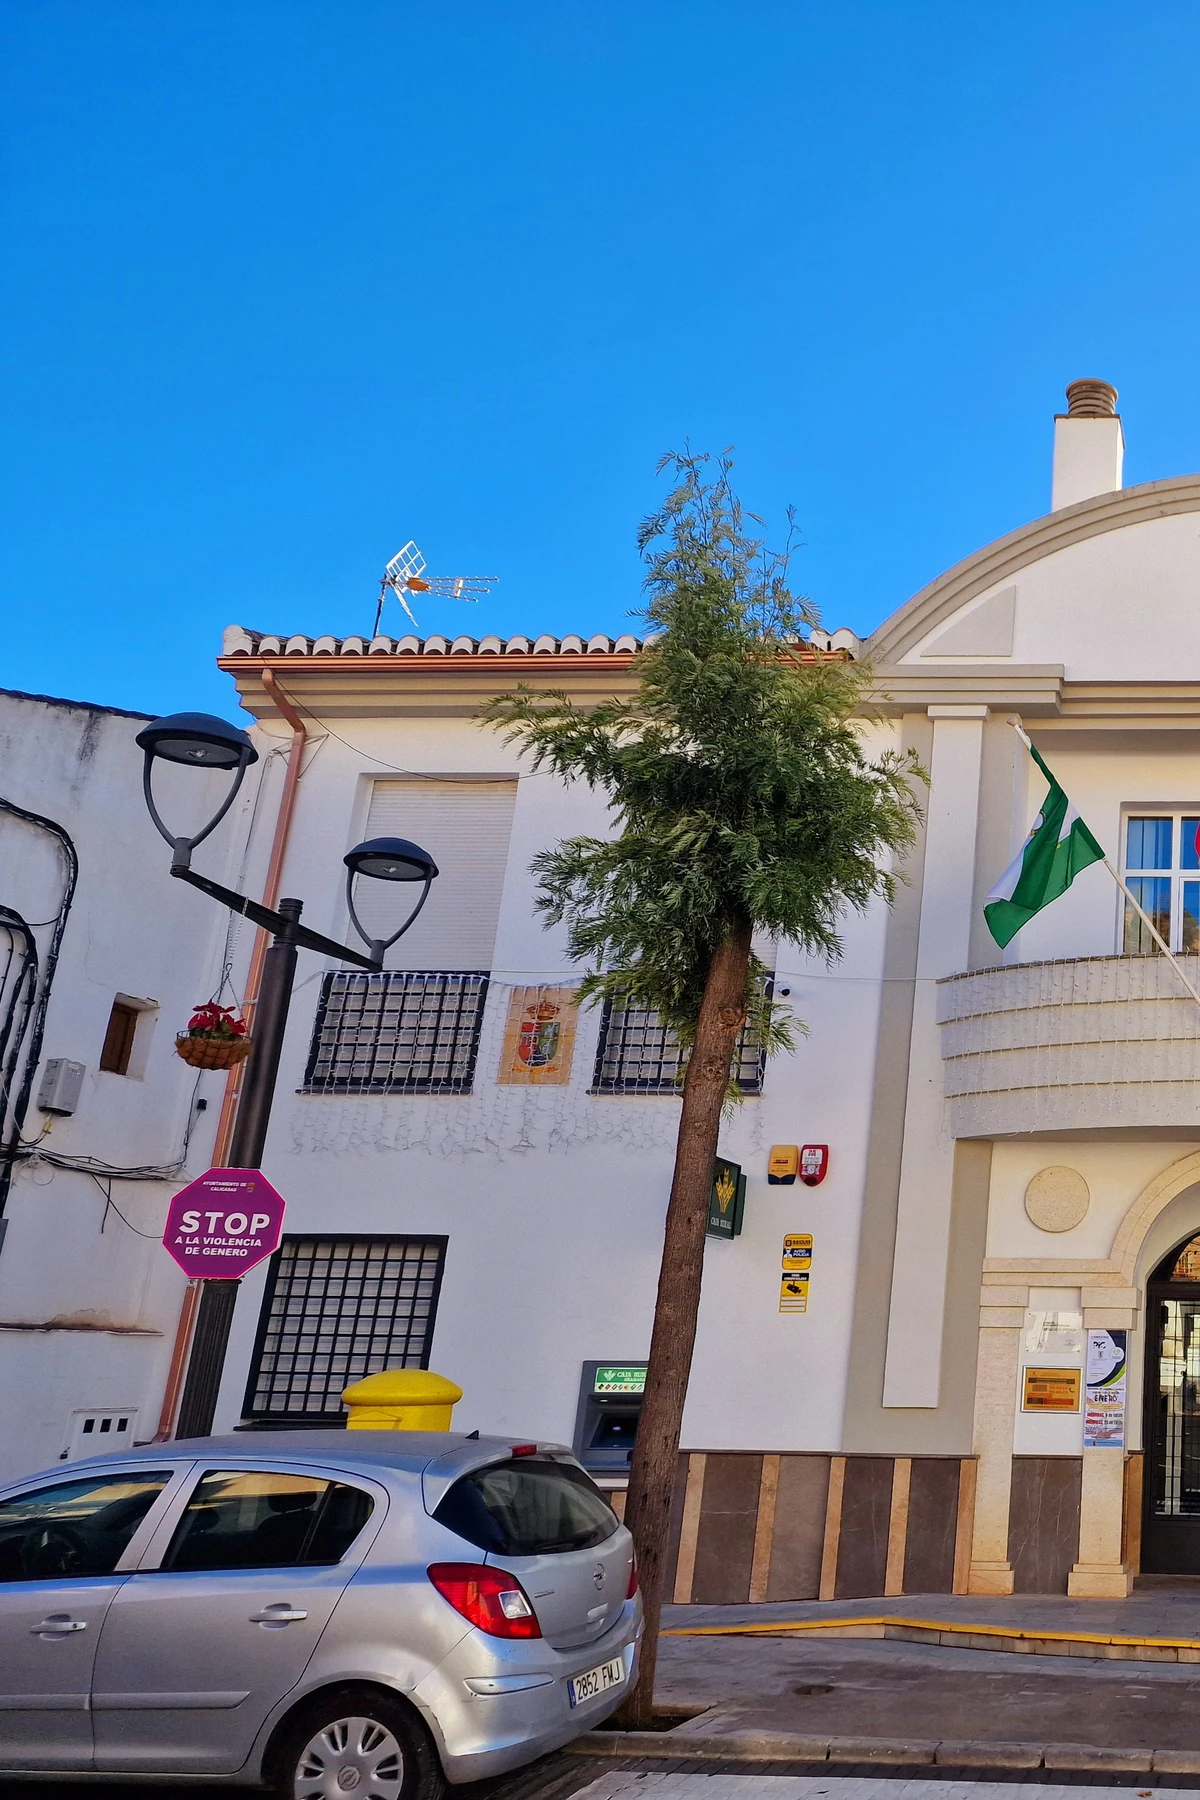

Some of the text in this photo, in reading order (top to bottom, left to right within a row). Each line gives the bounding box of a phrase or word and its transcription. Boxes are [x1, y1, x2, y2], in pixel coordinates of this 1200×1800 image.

[178, 1210, 270, 1235] STOP
[174, 1236, 262, 1247] A LA VIOLENCIA
[184, 1246, 248, 1257] DE GENERO
[1094, 1395, 1118, 1403] ENERO
[575, 1671, 599, 1700] 2852
